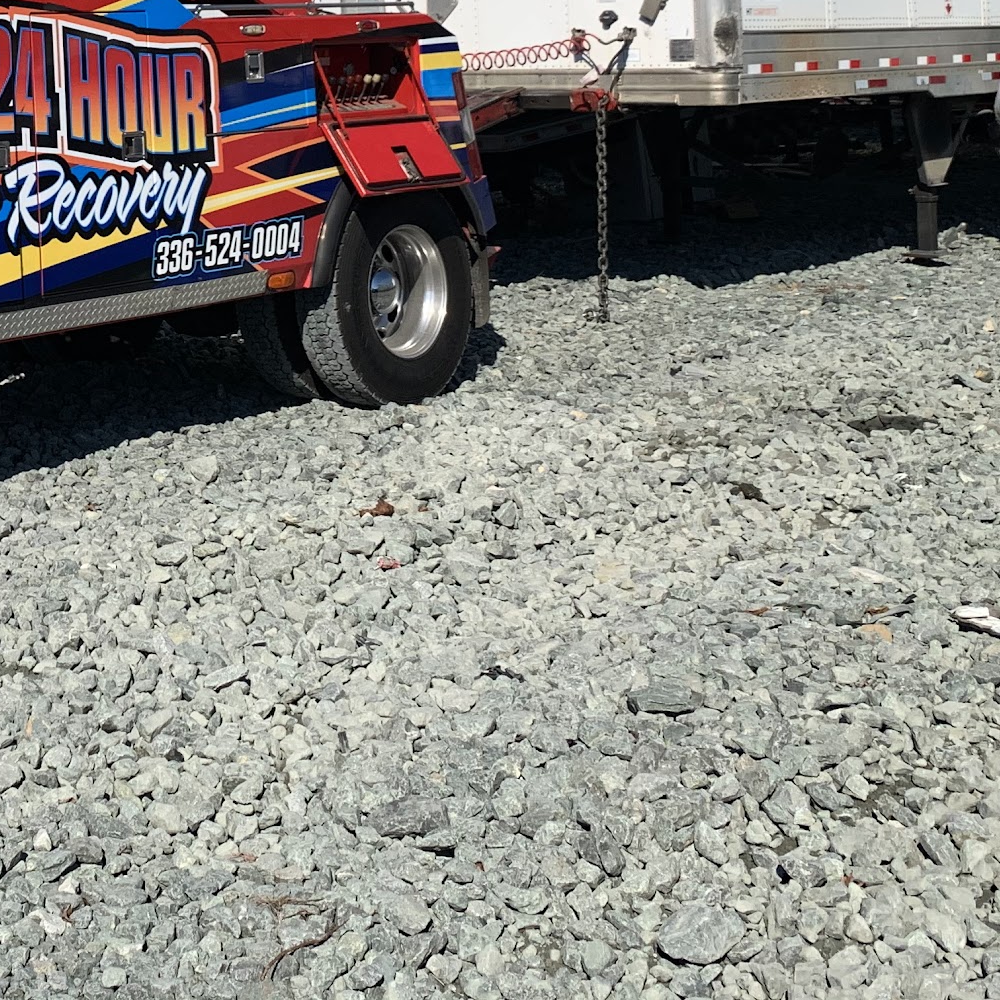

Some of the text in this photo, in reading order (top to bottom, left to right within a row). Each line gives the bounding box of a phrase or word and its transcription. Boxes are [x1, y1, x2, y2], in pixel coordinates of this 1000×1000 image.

[66, 33, 208, 154] HOUR
[4, 159, 206, 244] Recovery
[156, 221, 301, 276] 336-524-0004
